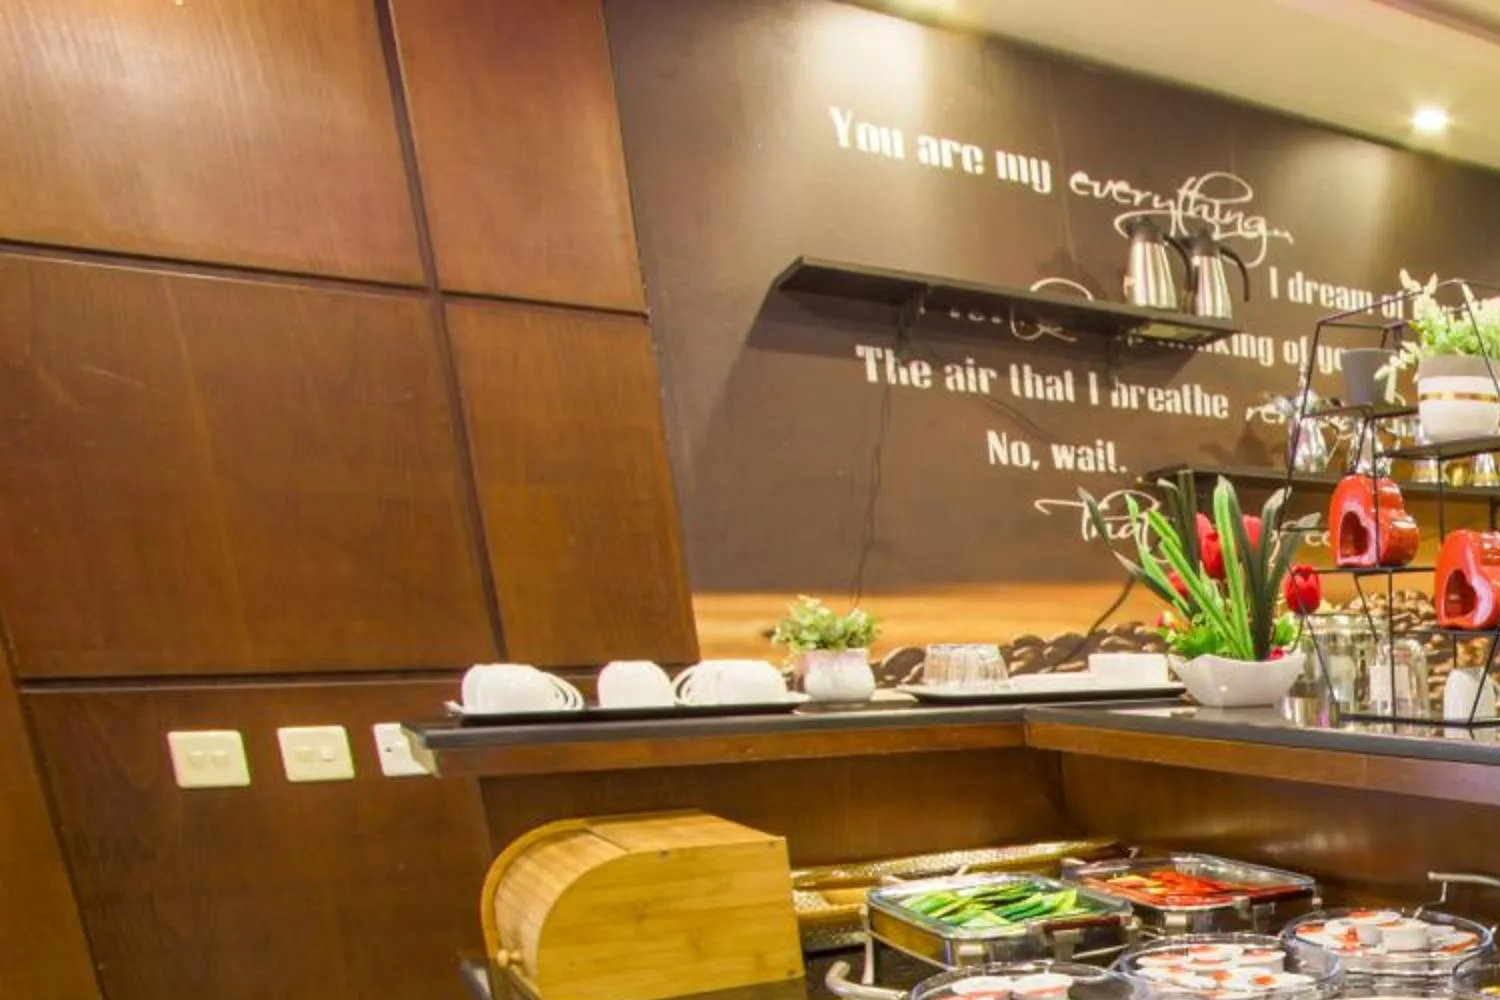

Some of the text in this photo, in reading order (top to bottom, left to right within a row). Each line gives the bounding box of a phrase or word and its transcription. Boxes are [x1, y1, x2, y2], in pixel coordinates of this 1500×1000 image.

[830, 106, 904, 159] You
[917, 133, 985, 175] are
[996, 150, 1052, 194] my
[1270, 266, 1279, 299] I
[1287, 271, 1374, 311] dream
[856, 345, 1229, 419] The air that I breathe
[986, 430, 1127, 473] No, wait.
